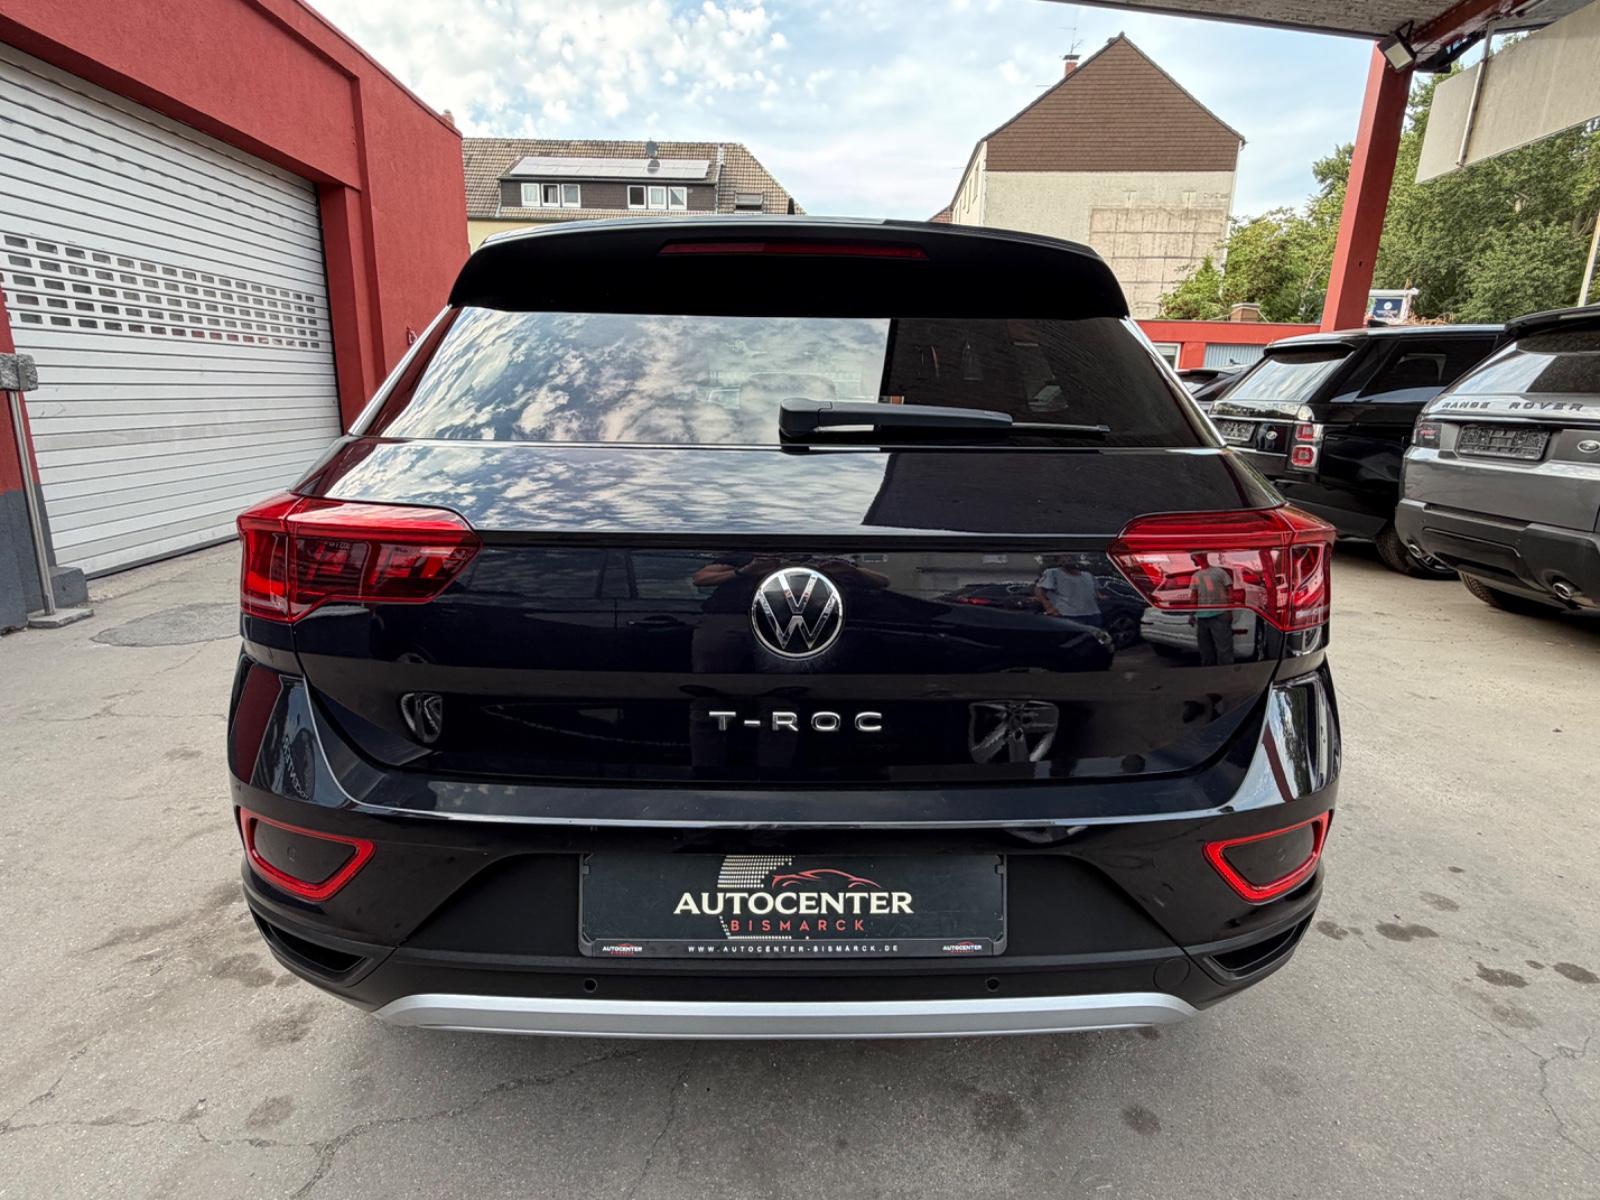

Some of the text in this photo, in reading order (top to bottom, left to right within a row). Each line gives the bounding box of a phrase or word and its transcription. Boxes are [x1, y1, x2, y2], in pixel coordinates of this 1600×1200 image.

[1442, 402, 1584, 411] RANGE ROVER
[709, 711, 883, 732] T-ROC
[673, 892, 915, 915] AUTOCENTER
[730, 919, 866, 932] BISMARCK
[687, 945, 899, 953] WWW.AUTOCENTER-BISMARCK.DE
